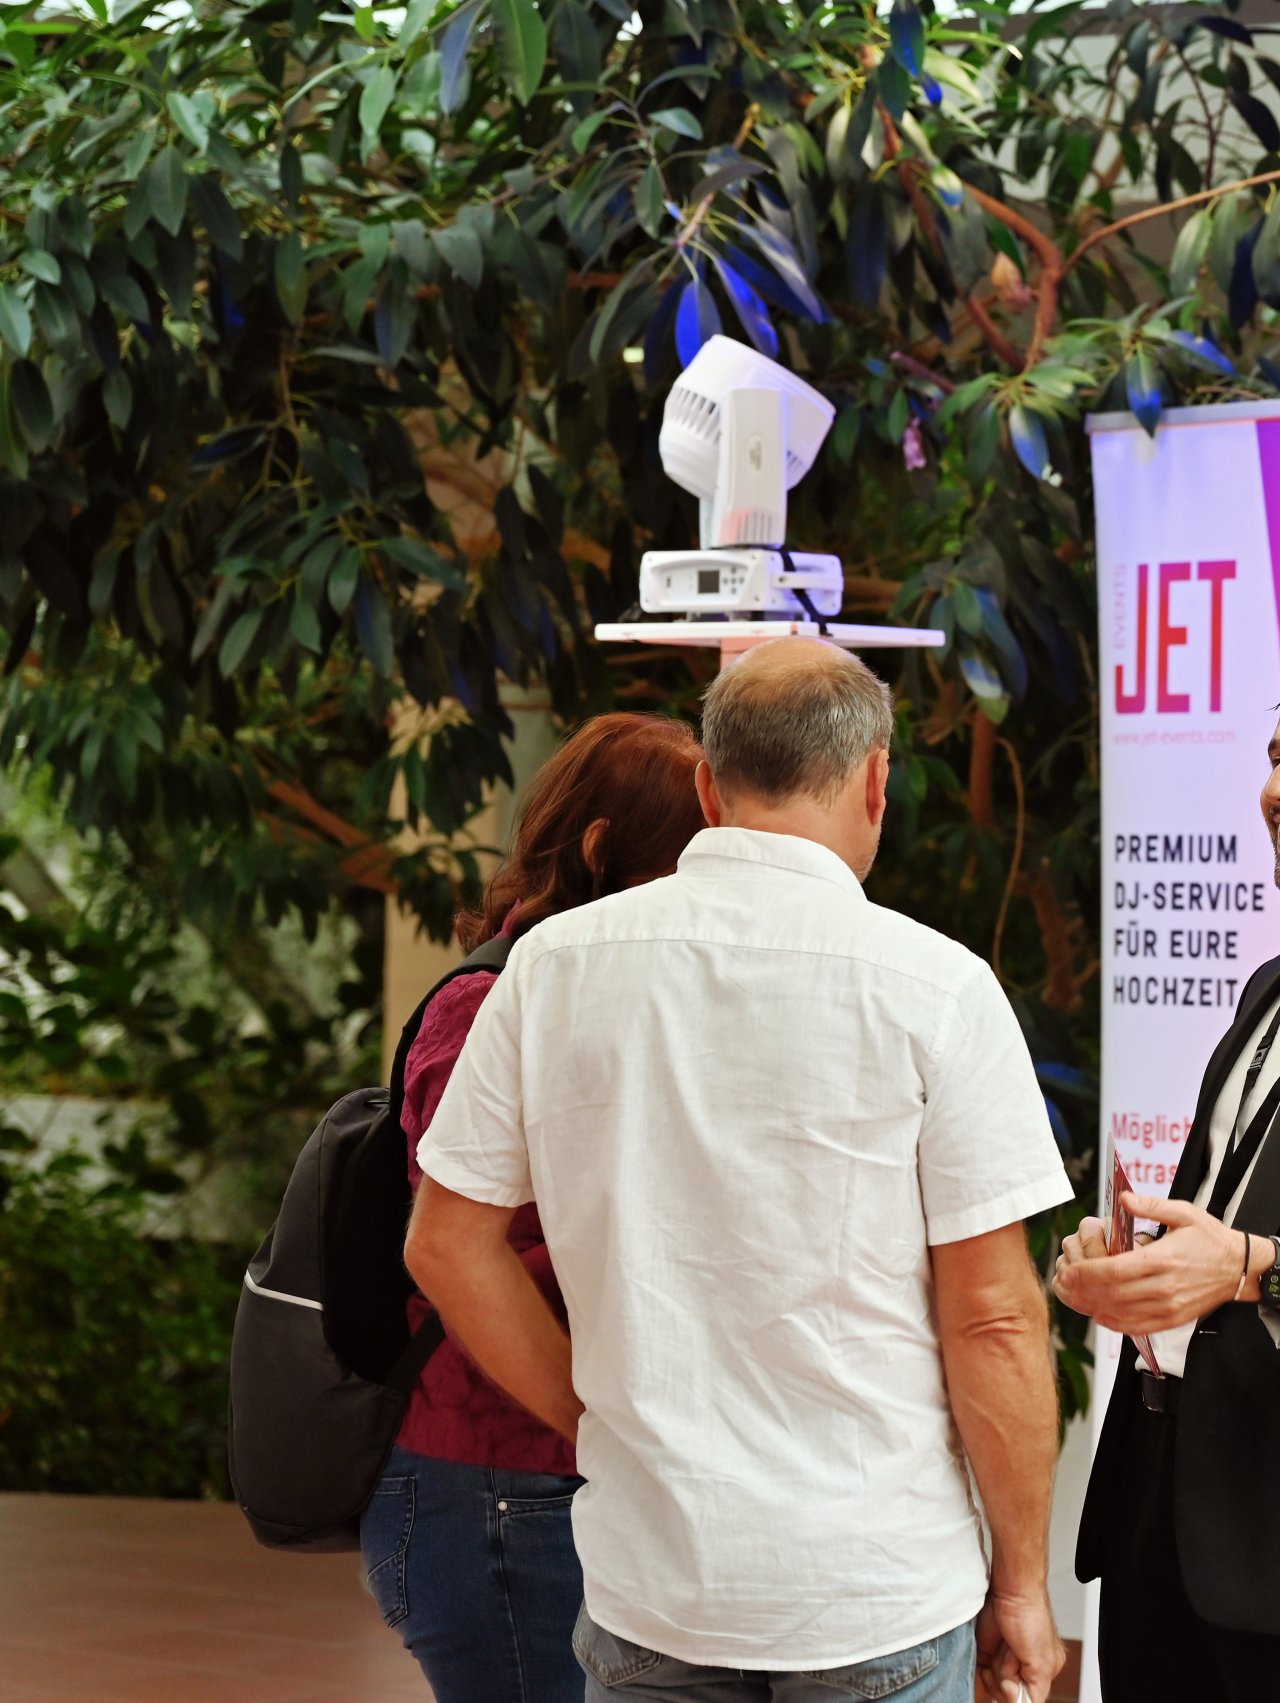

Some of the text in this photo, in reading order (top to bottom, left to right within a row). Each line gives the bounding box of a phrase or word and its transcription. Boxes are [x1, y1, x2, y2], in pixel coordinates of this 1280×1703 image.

[1115, 560, 1236, 715] JET
[1114, 834, 1238, 864] PREMIUM
[1114, 881, 1265, 912] DJ-SERVICE
[1114, 920, 1239, 960] FÜR EURE
[1113, 975, 1239, 1008] HOCHZEIT
[1112, 1111, 1193, 1149] Möglich
